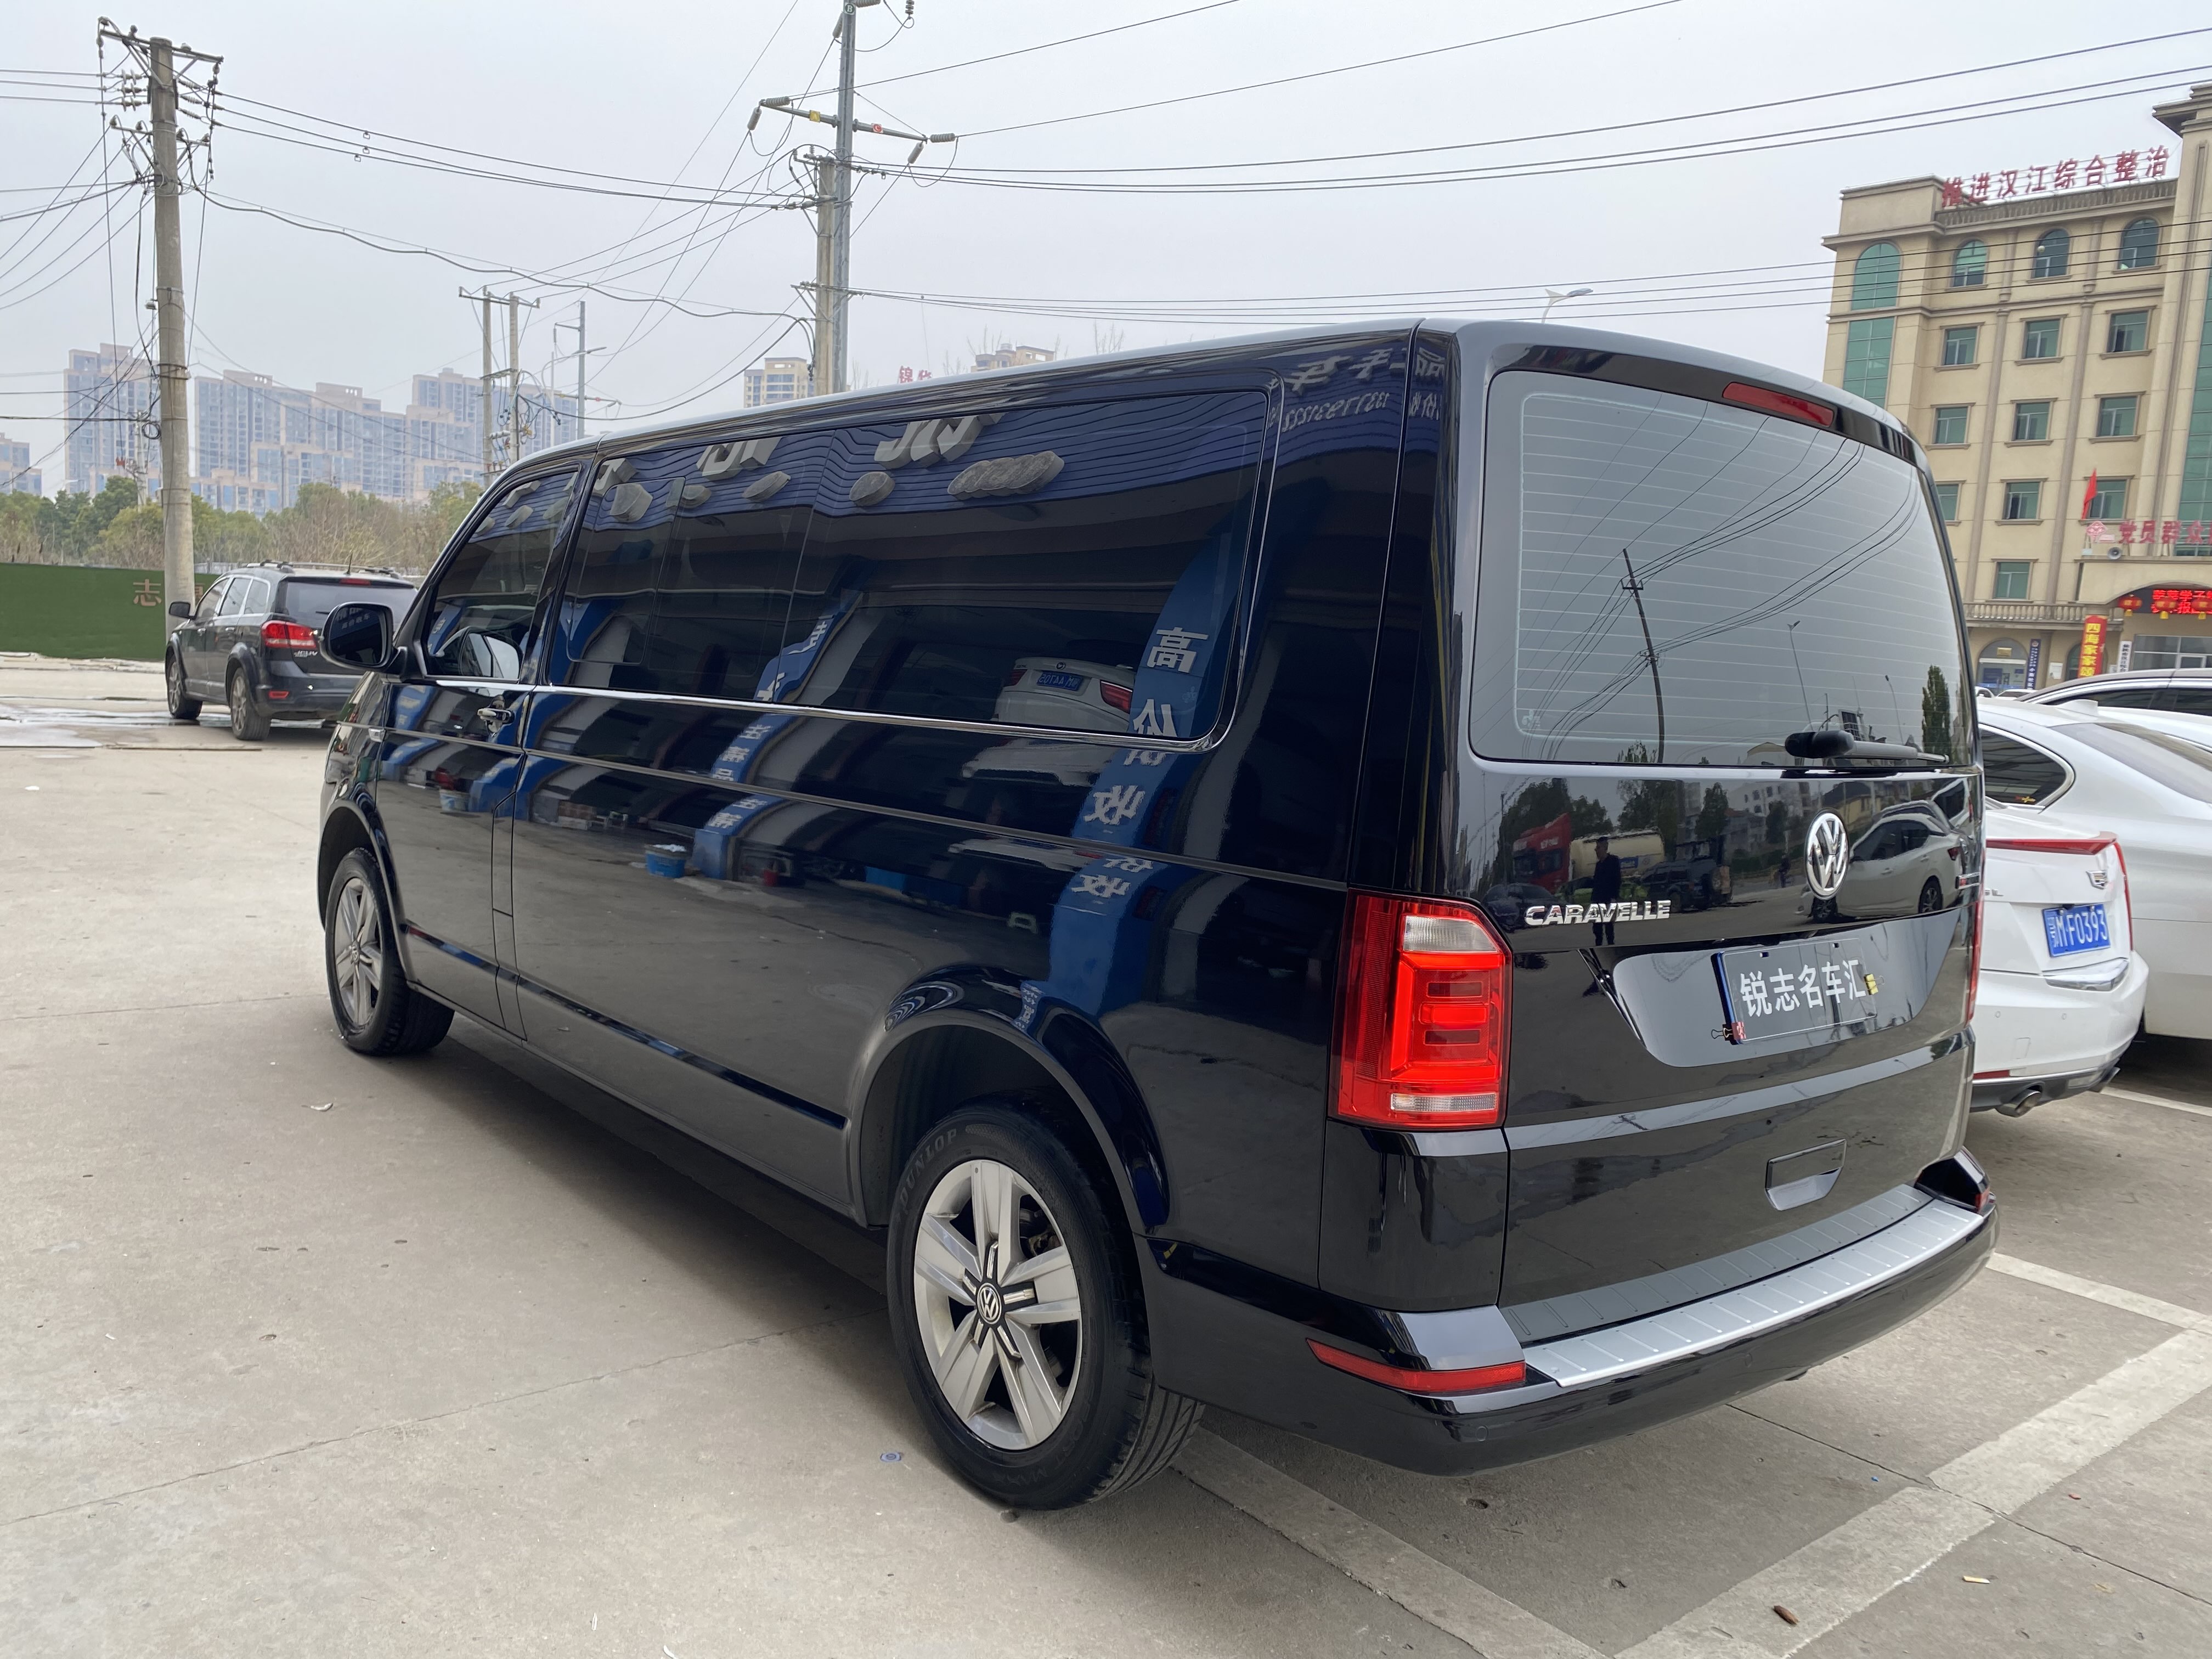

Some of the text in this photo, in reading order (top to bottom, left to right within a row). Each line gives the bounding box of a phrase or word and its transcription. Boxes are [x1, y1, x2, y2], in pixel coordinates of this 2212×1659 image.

[1942, 145, 2169, 207] 推进汉江综合整治
[2118, 520, 2212, 544] 党员群众
[1525, 899, 1672, 927] CARAVELLE
[1739, 958, 1867, 1018] 锐志名车汇
[900, 1128, 957, 1206] DUNLOP
